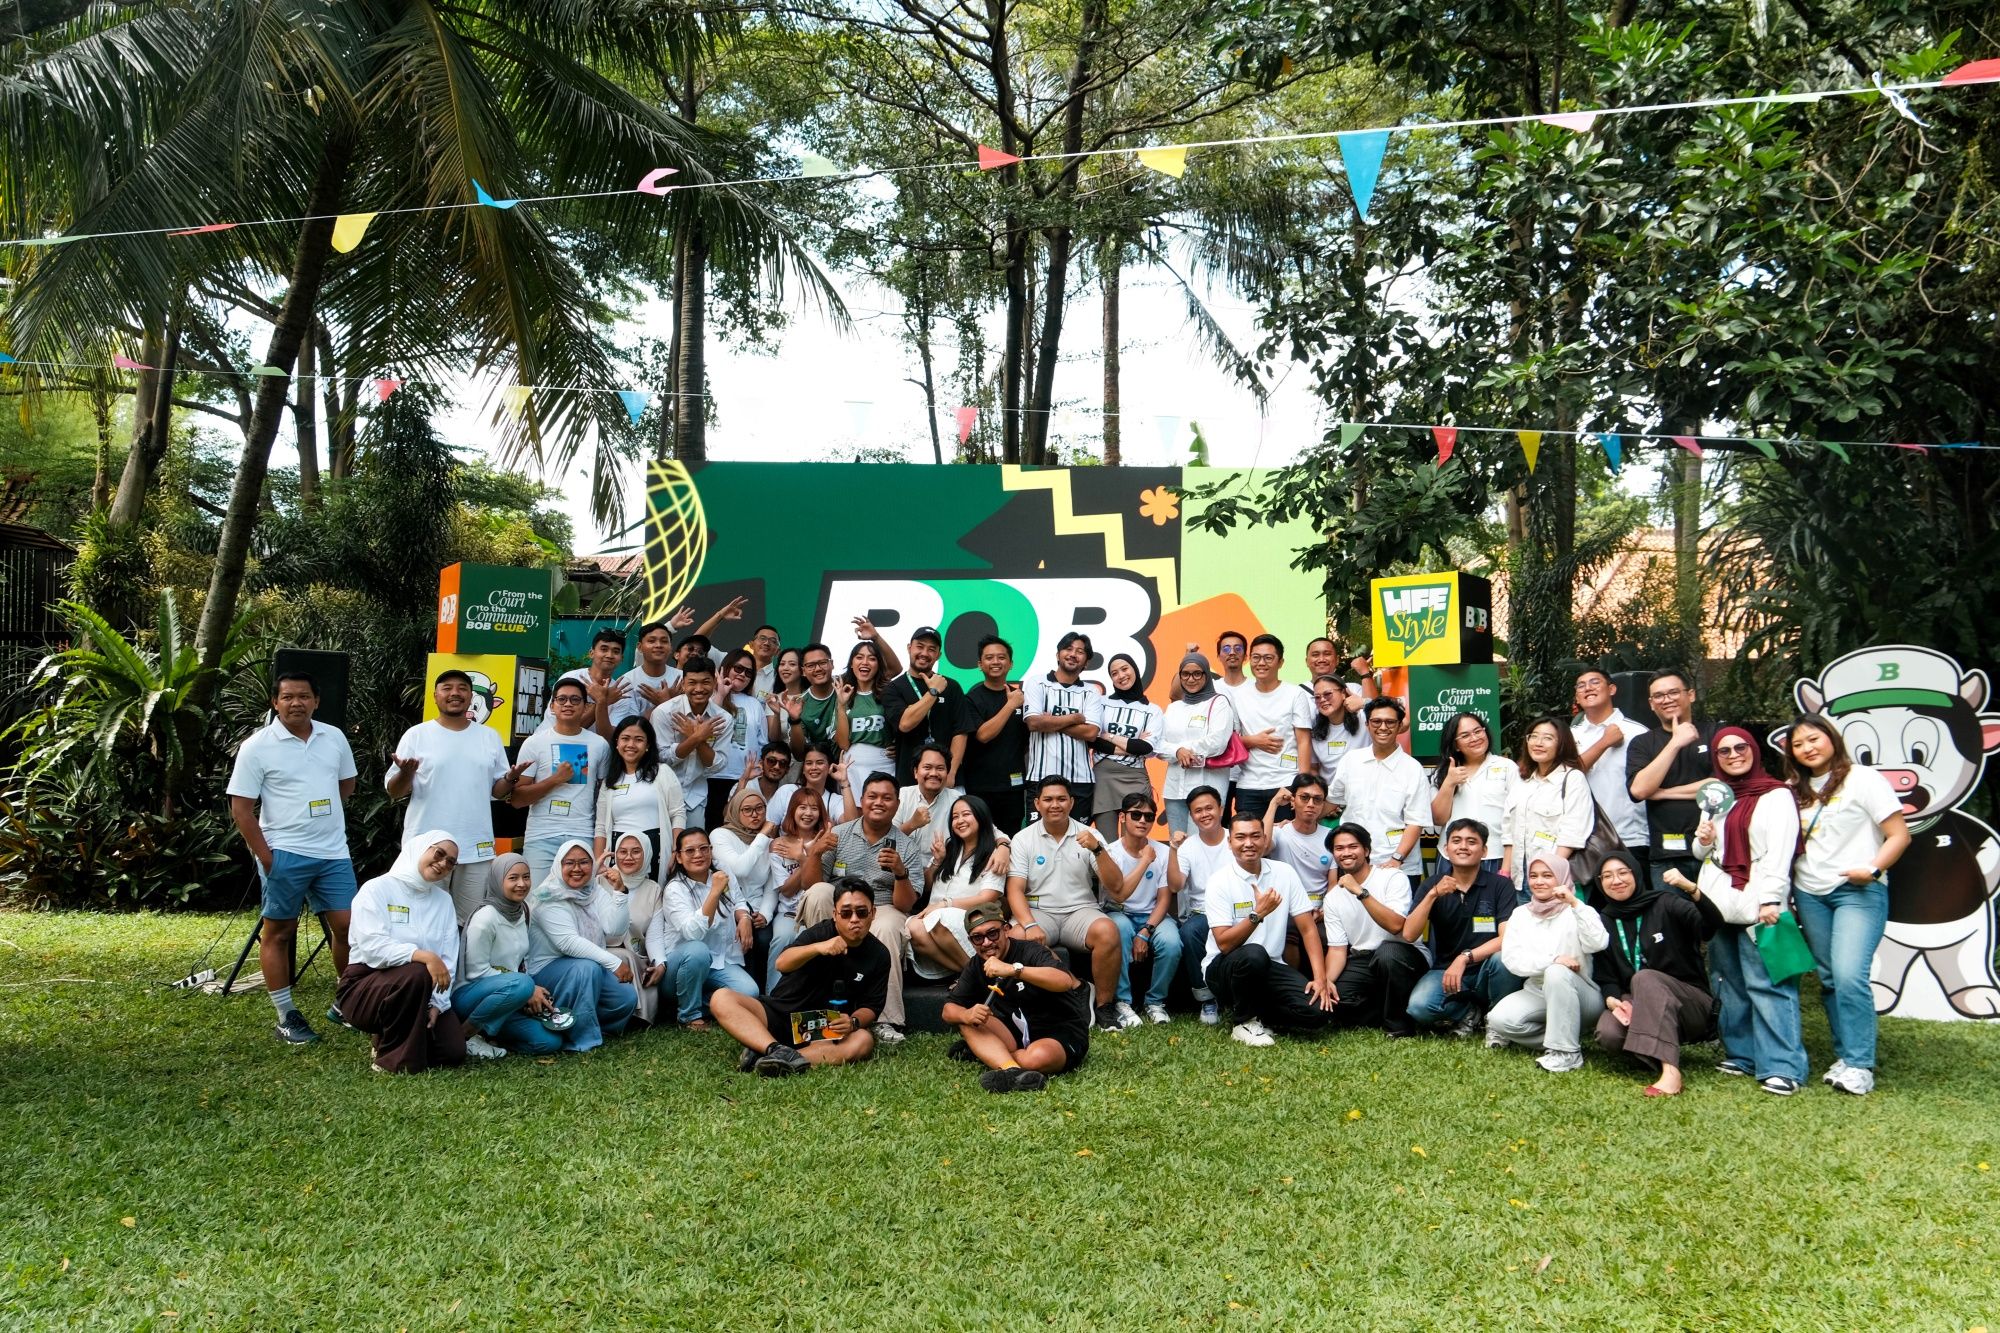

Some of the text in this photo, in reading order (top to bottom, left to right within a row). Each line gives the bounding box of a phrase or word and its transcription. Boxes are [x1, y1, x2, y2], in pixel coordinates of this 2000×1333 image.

[488, 590, 526, 608] Court
[502, 590, 543, 600] From the
[1383, 587, 1449, 616] LIFE
[480, 604, 507, 613] to the
[466, 605, 540, 628] Community,
[466, 621, 527, 633] BOB CLUB.
[1390, 605, 1445, 650] Style
[1876, 662, 1900, 682] B
[1476, 687, 1491, 695] the
[1437, 689, 1475, 706] Court
[1442, 704, 1457, 712] the
[1418, 722, 1443, 731] BOB
[1030, 811, 1039, 820] B
[1936, 835, 1951, 847] B
[854, 972, 864, 982] B
[1016, 981, 1025, 992] B
